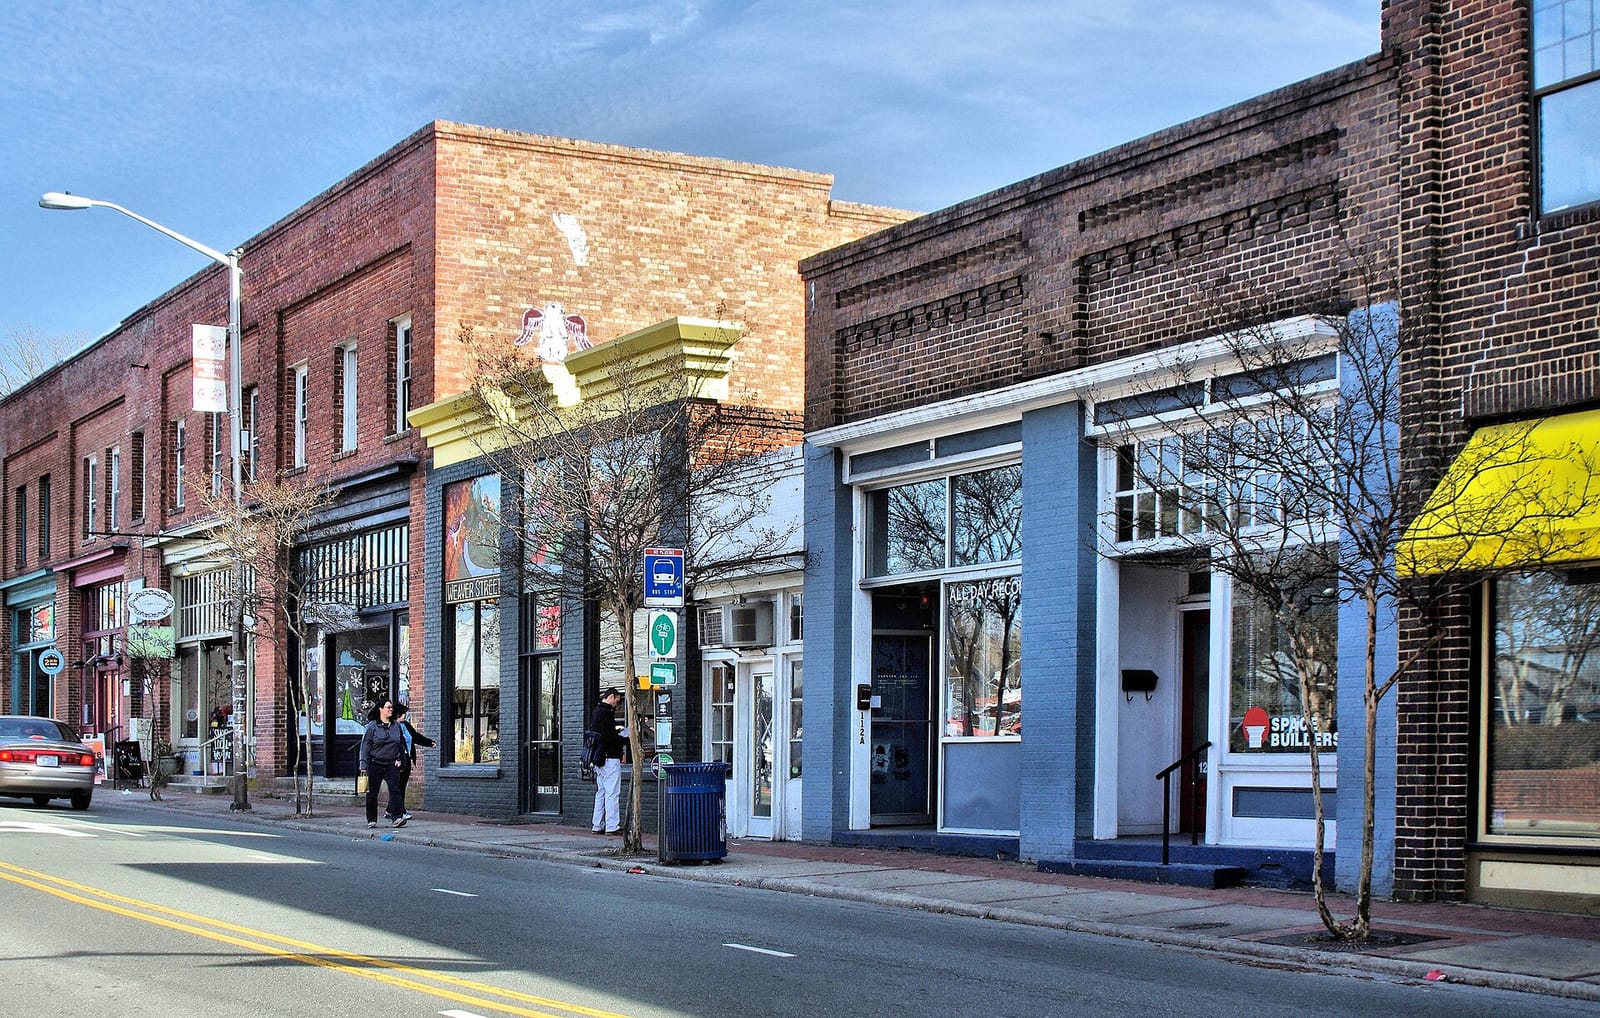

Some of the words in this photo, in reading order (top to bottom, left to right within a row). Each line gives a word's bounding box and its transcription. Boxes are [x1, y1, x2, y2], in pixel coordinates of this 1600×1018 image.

[447, 582, 474, 601] WEAVER
[949, 586, 968, 602] ALL
[971, 583, 989, 599] DAY
[1271, 717, 1318, 732] SPACE
[1270, 732, 1339, 747] BUILDERS
